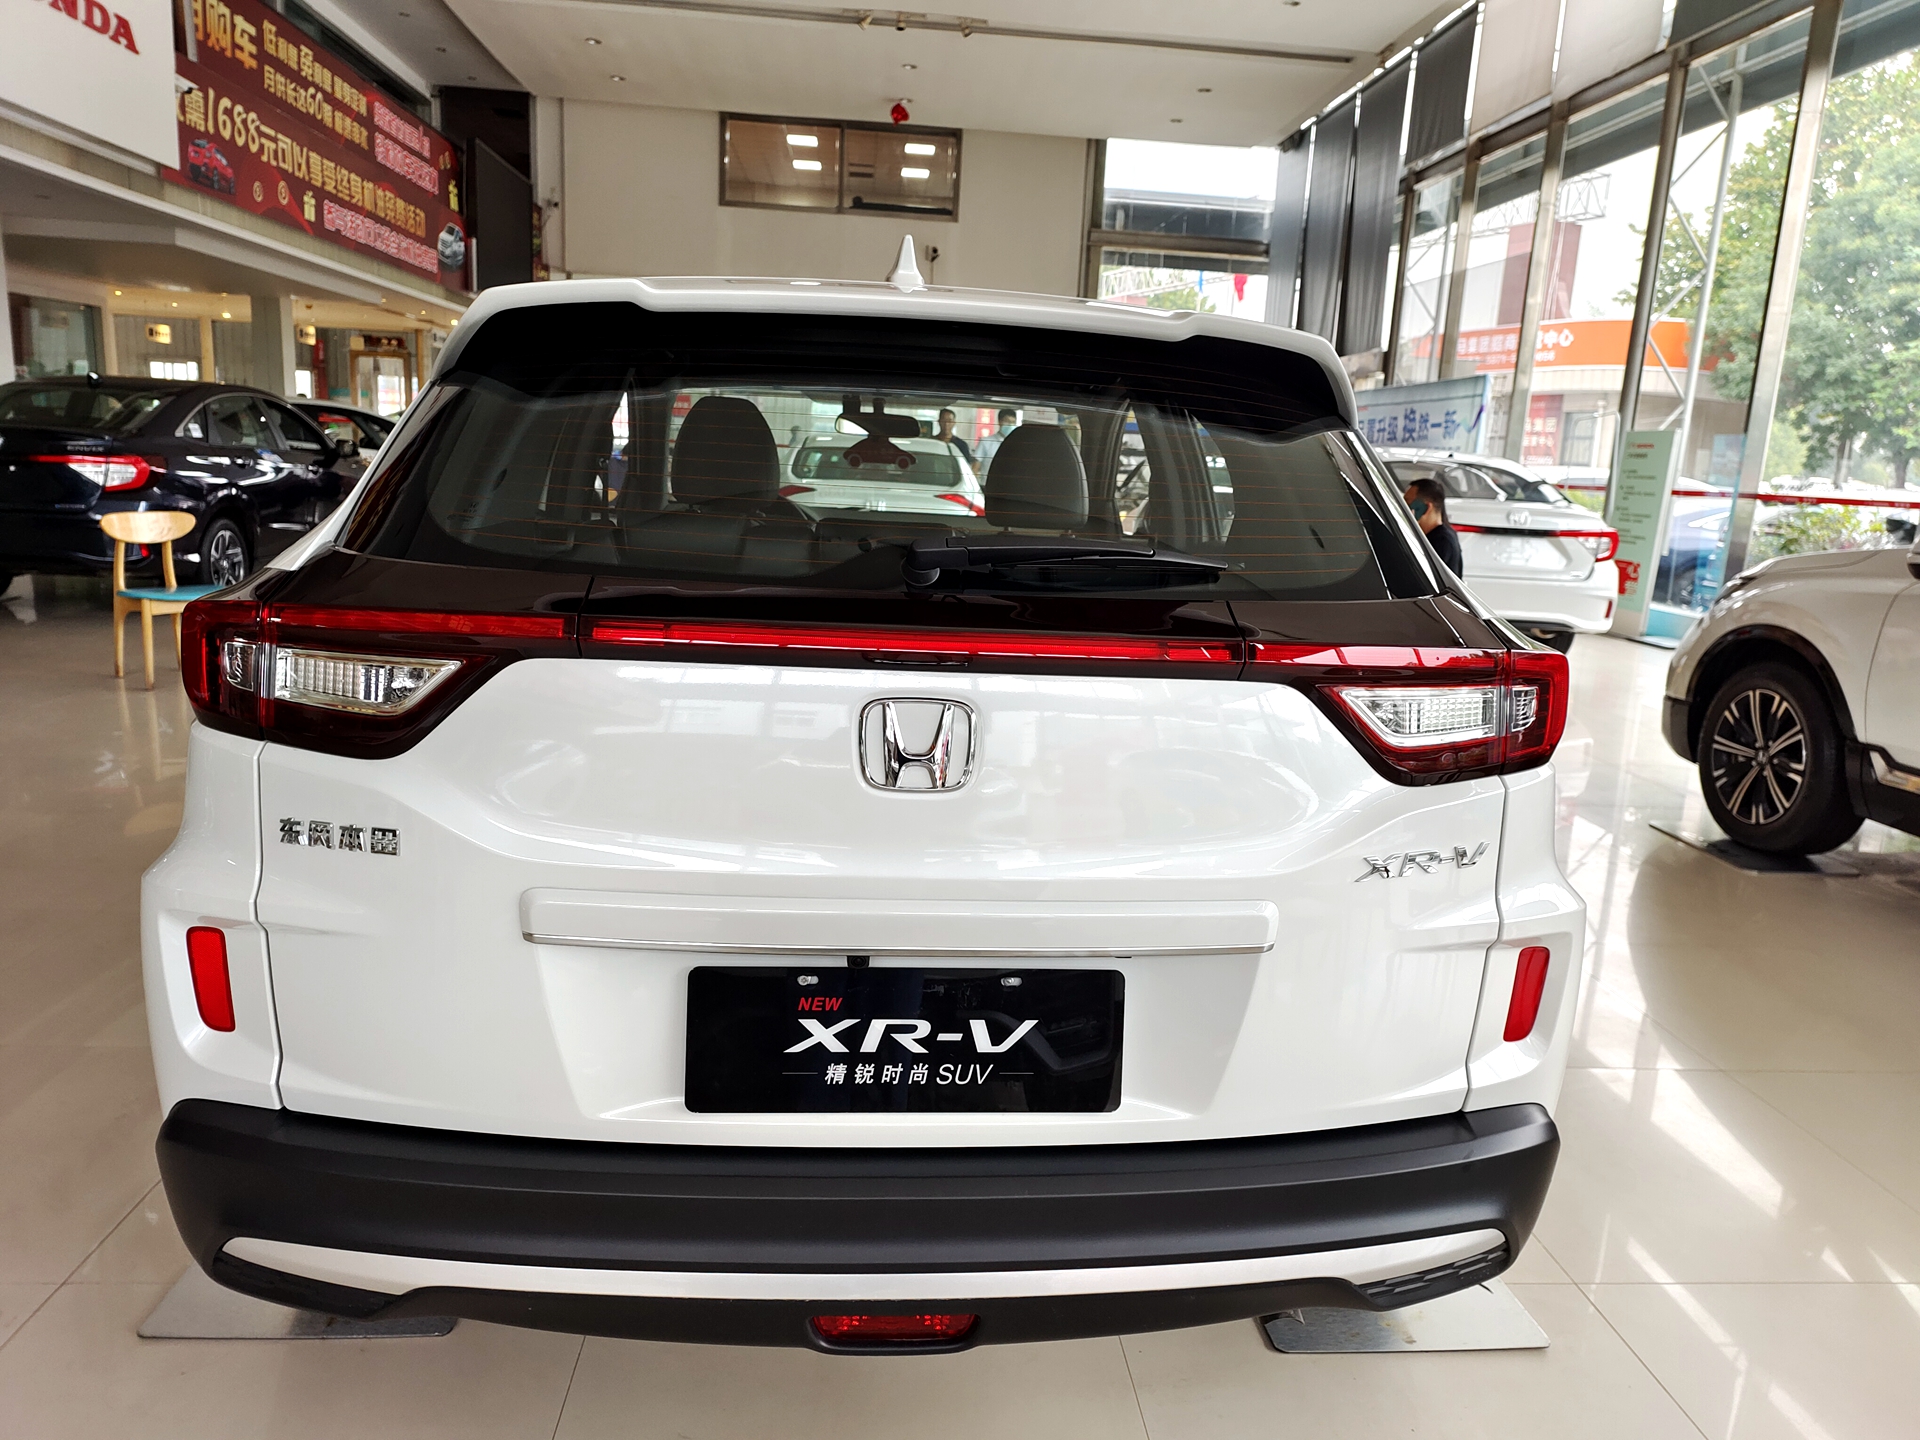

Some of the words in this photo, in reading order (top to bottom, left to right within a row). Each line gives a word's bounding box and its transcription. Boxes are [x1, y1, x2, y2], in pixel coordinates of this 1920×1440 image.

[1353, 840, 1491, 883] XR-V
[797, 996, 843, 1012] NEW
[782, 1018, 1040, 1054] XR-V
[824, 1063, 930, 1086] 精锐时尚
[935, 1064, 994, 1086] SUV
